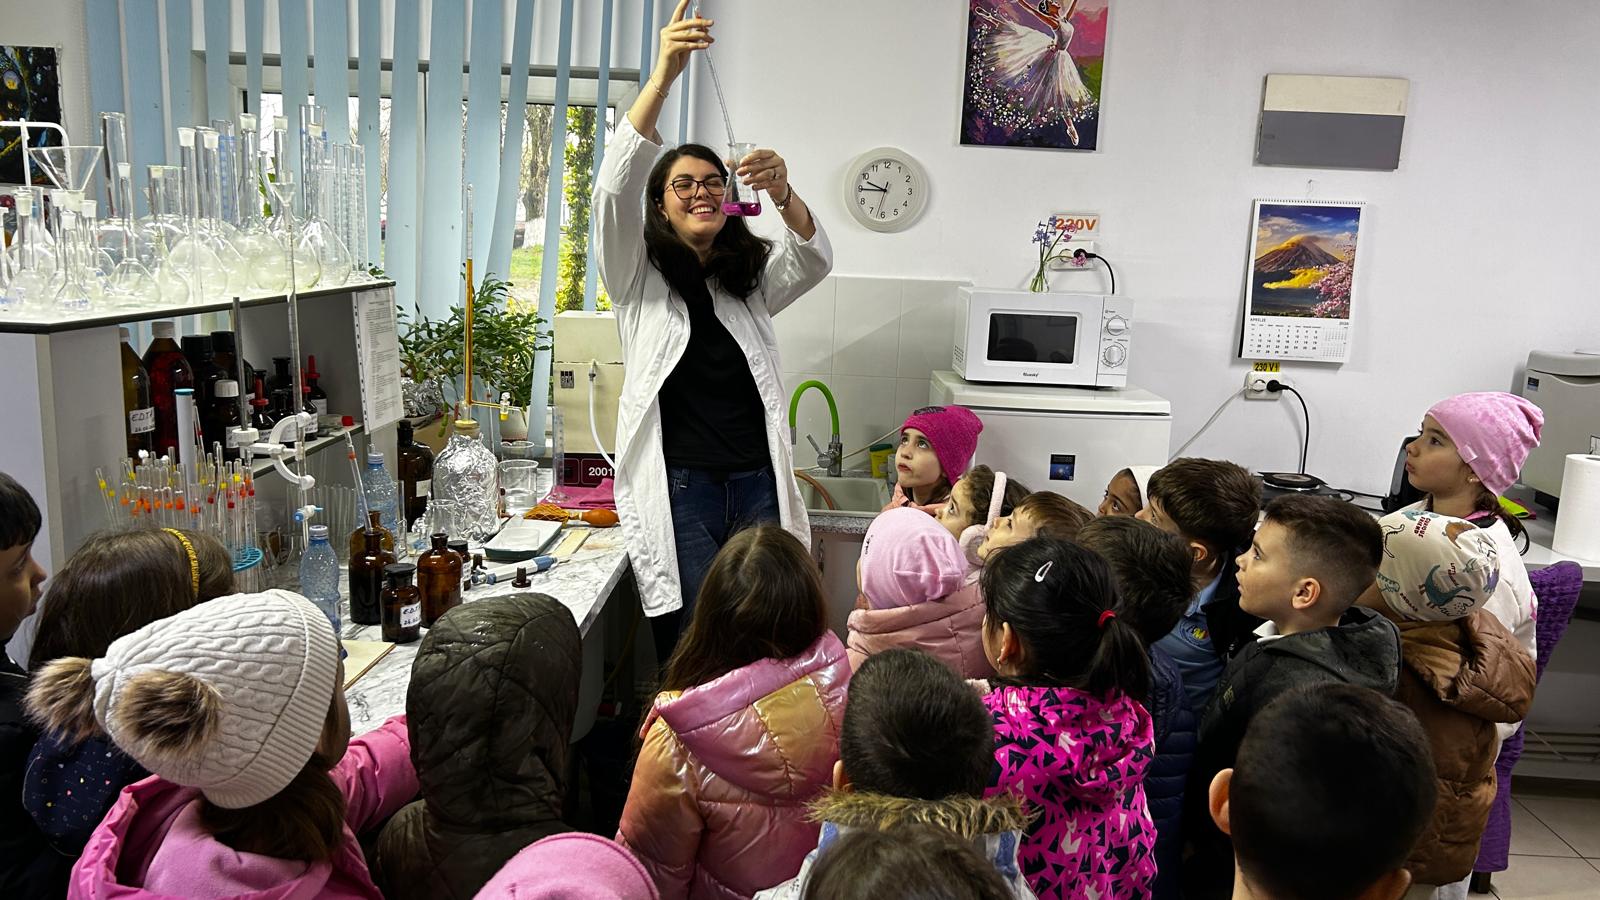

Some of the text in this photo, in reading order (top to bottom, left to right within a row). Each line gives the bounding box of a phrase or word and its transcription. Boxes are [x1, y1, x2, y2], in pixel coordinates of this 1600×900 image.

[884, 161, 891, 169] 12
[862, 172, 869, 180] 10
[588, 466, 615, 476] 2001
